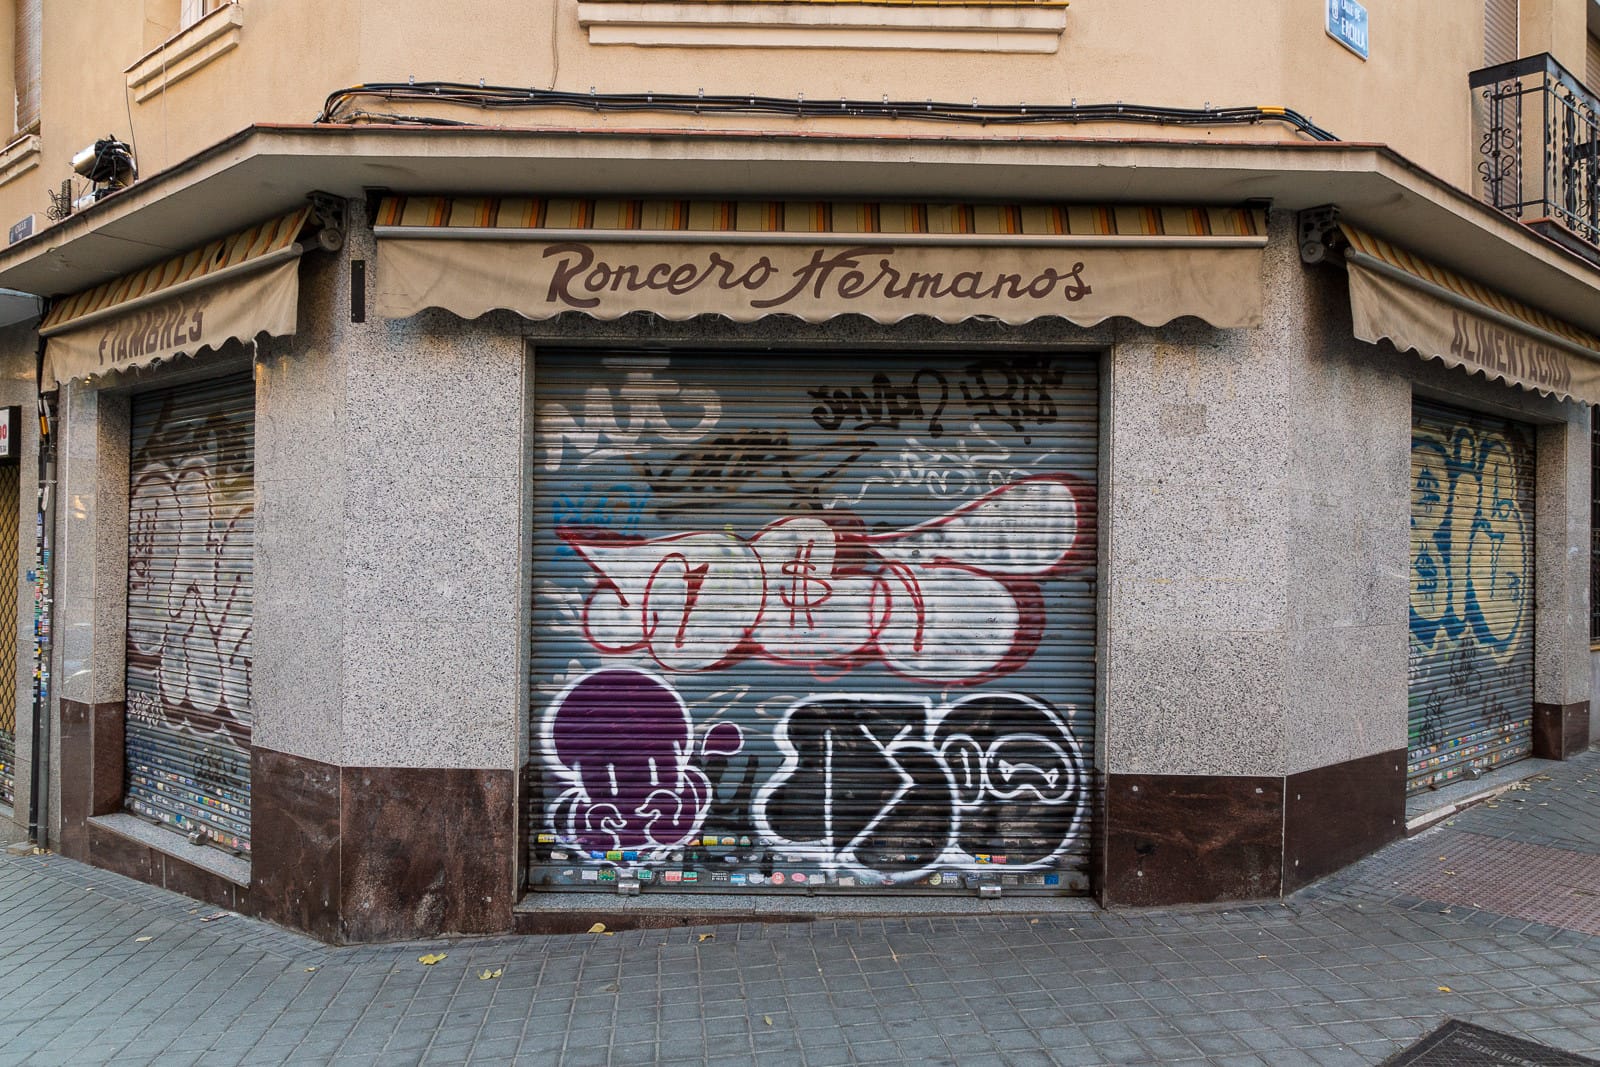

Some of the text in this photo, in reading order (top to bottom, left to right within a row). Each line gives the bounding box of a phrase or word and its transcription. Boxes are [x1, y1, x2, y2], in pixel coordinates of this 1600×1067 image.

[542, 243, 1093, 309] Roncero Hermanos
[98, 295, 209, 366] FIAMBRES
[1450, 311, 1572, 391] ALIMENTACION
